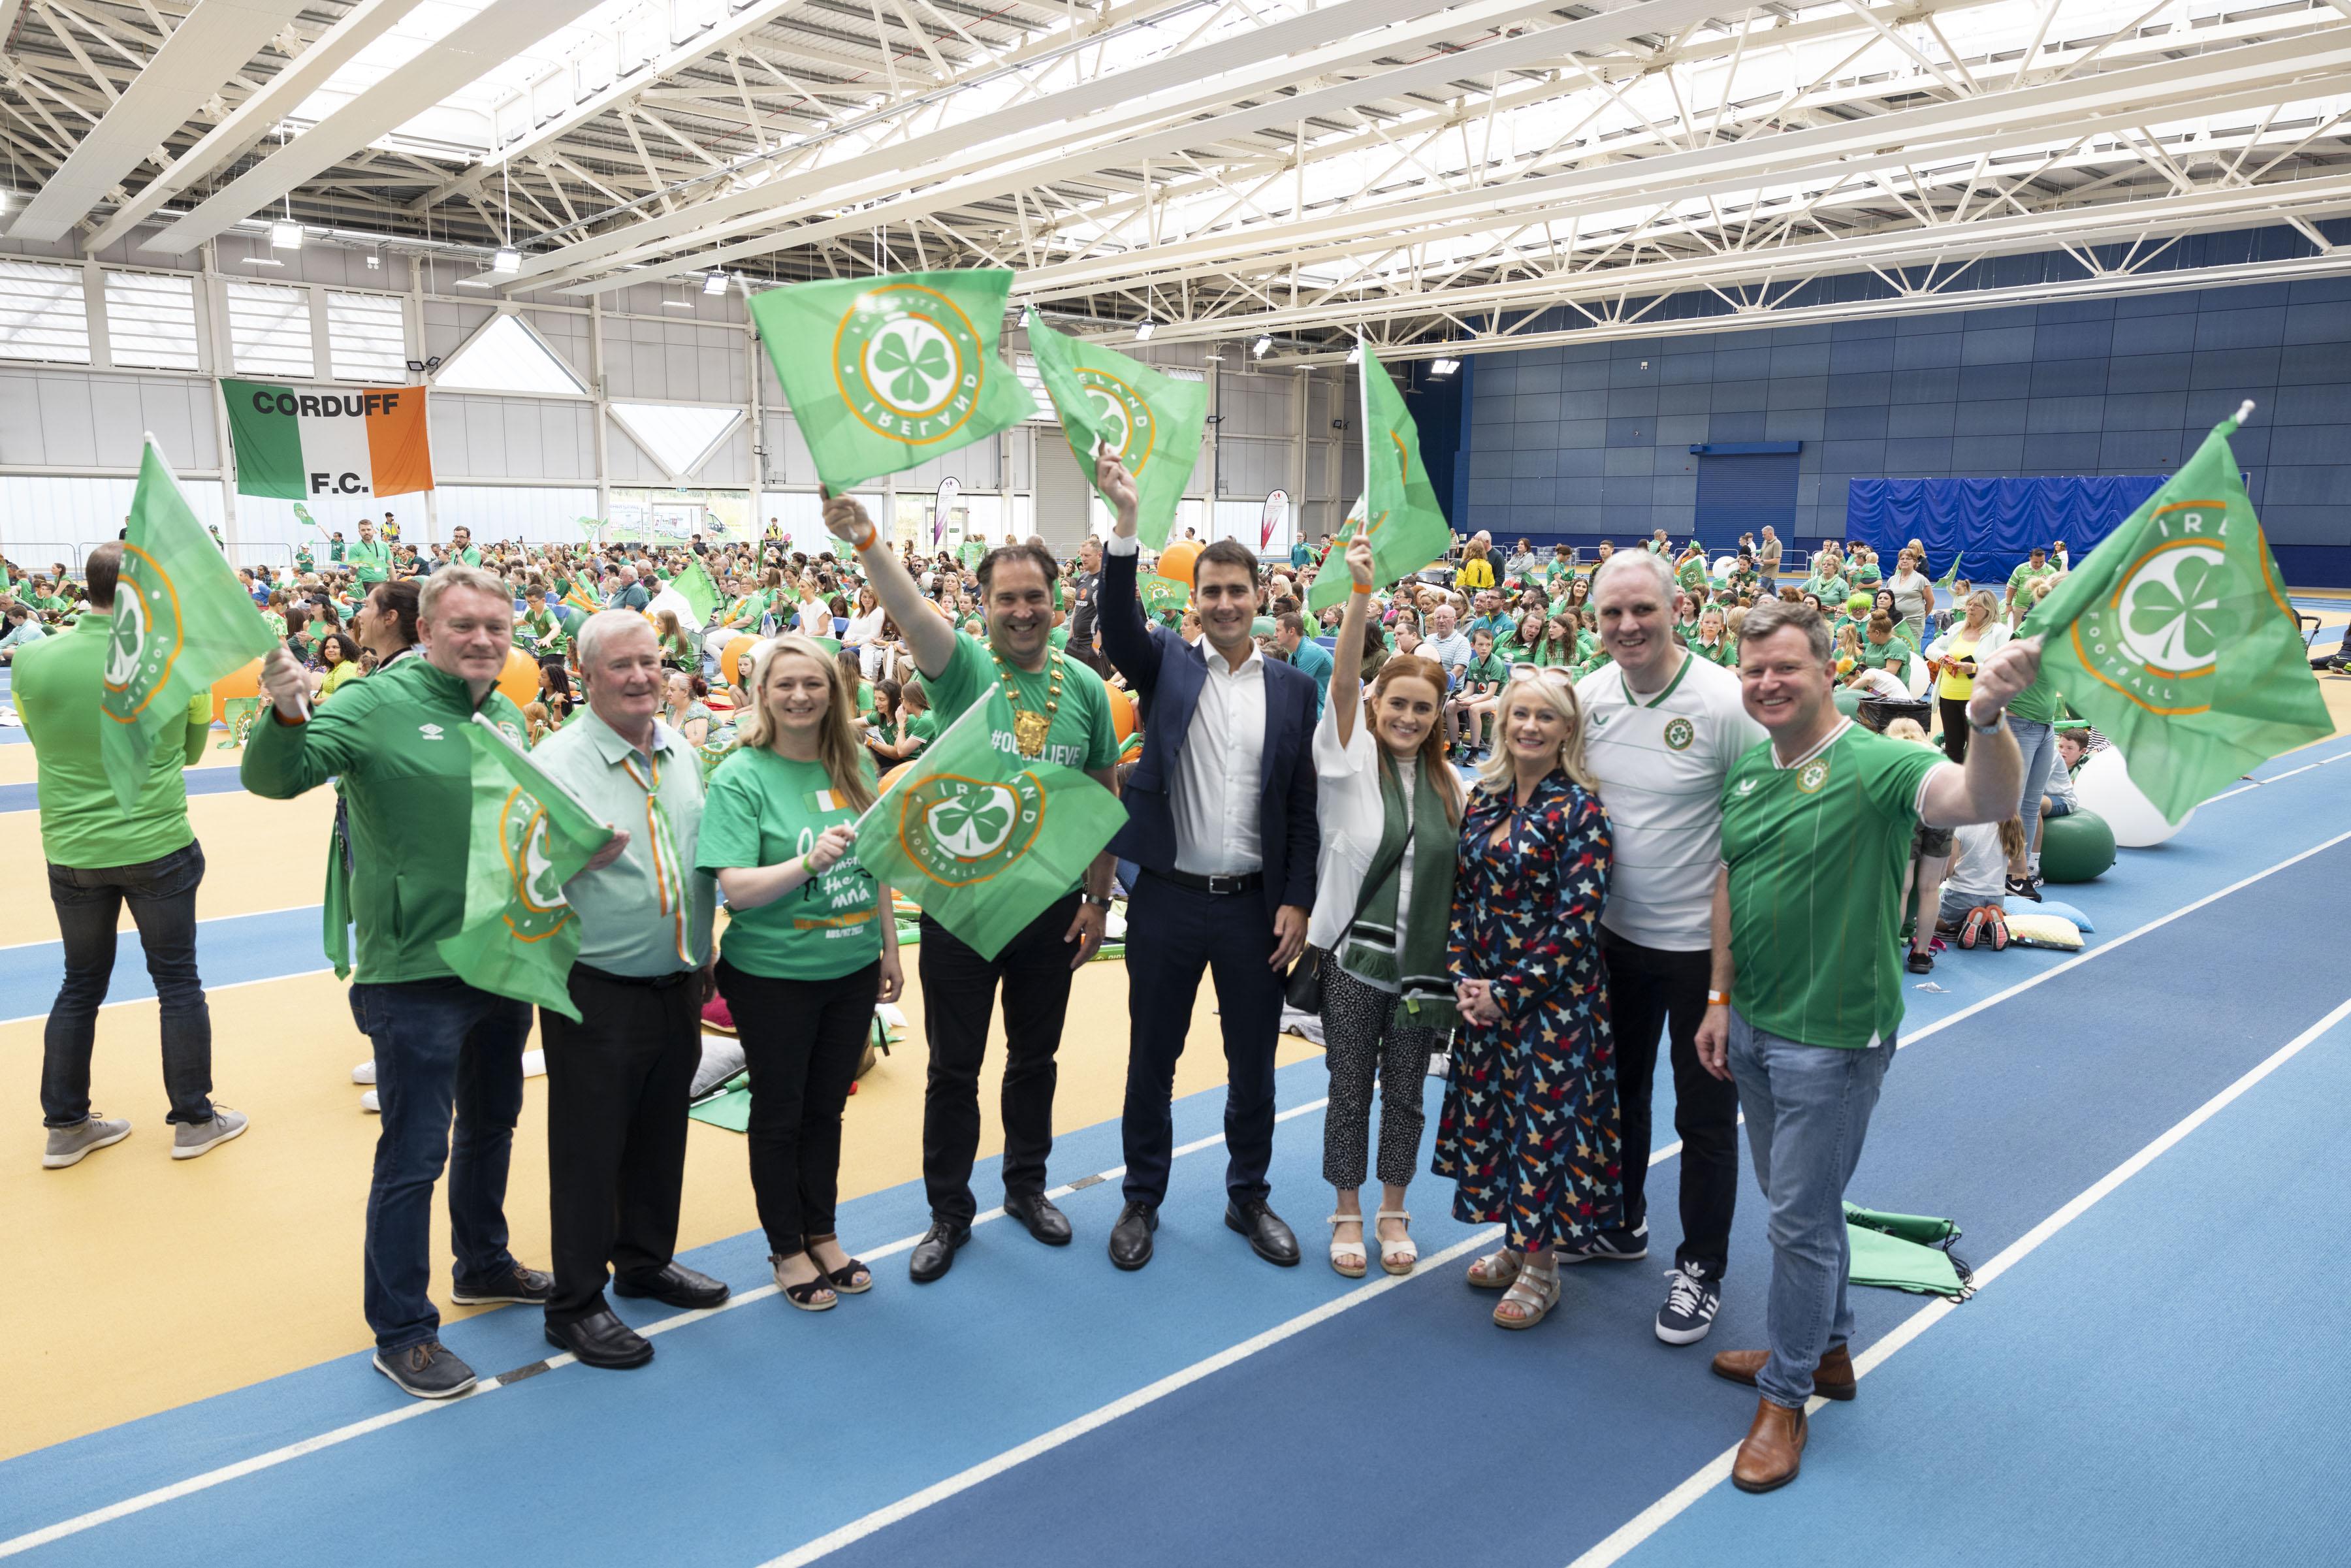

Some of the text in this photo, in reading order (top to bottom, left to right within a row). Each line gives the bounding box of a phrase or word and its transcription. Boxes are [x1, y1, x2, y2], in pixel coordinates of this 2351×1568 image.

[253, 391, 400, 417] CORDUFF
[310, 472, 369, 494] F.C.
[2088, 611, 2173, 700] FOOTBALL
[823, 876, 855, 895] the
